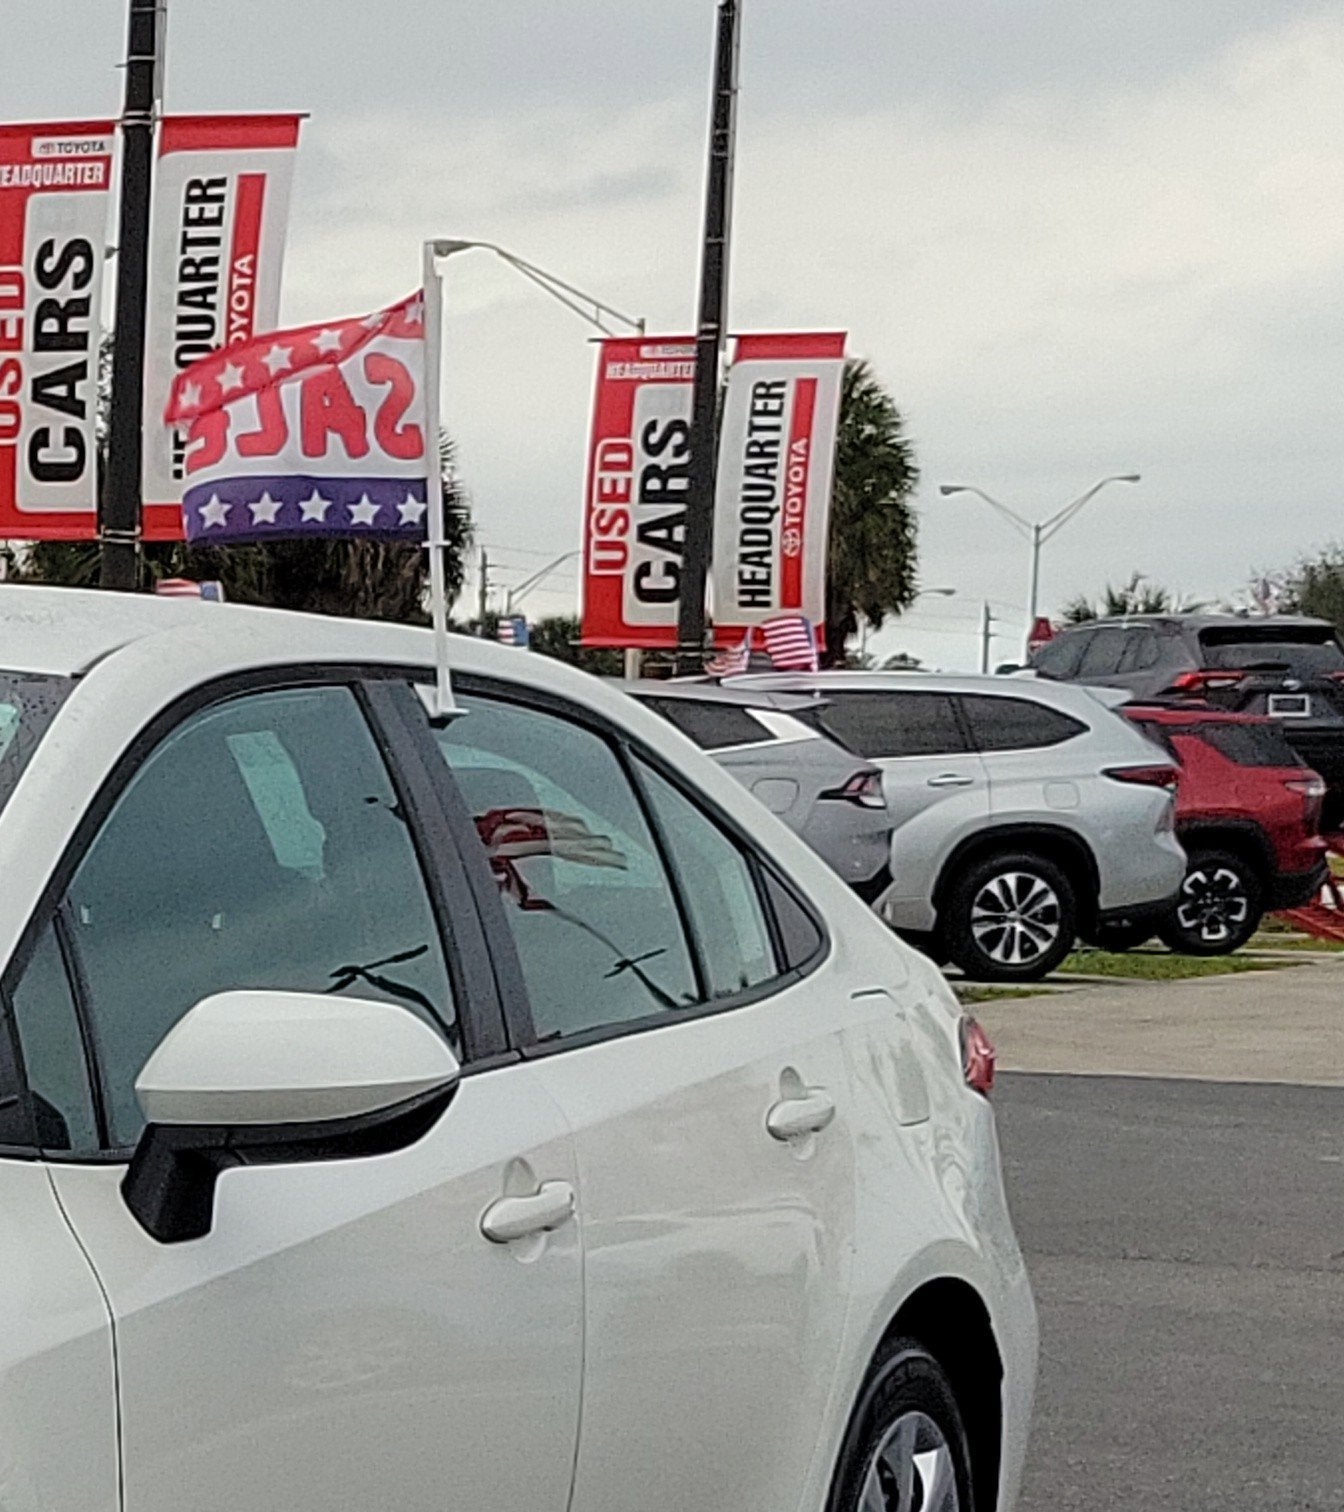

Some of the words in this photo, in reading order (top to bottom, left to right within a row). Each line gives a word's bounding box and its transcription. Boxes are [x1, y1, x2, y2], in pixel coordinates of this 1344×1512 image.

[57, 141, 105, 154] TOYOTA
[28, 238, 93, 482] CARS
[228, 254, 254, 348] OYOTA
[590, 438, 633, 574] USED
[633, 417, 690, 603] CARS
[738, 379, 787, 608] HEADQUARTER
[784, 438, 808, 528] TOYOTA
